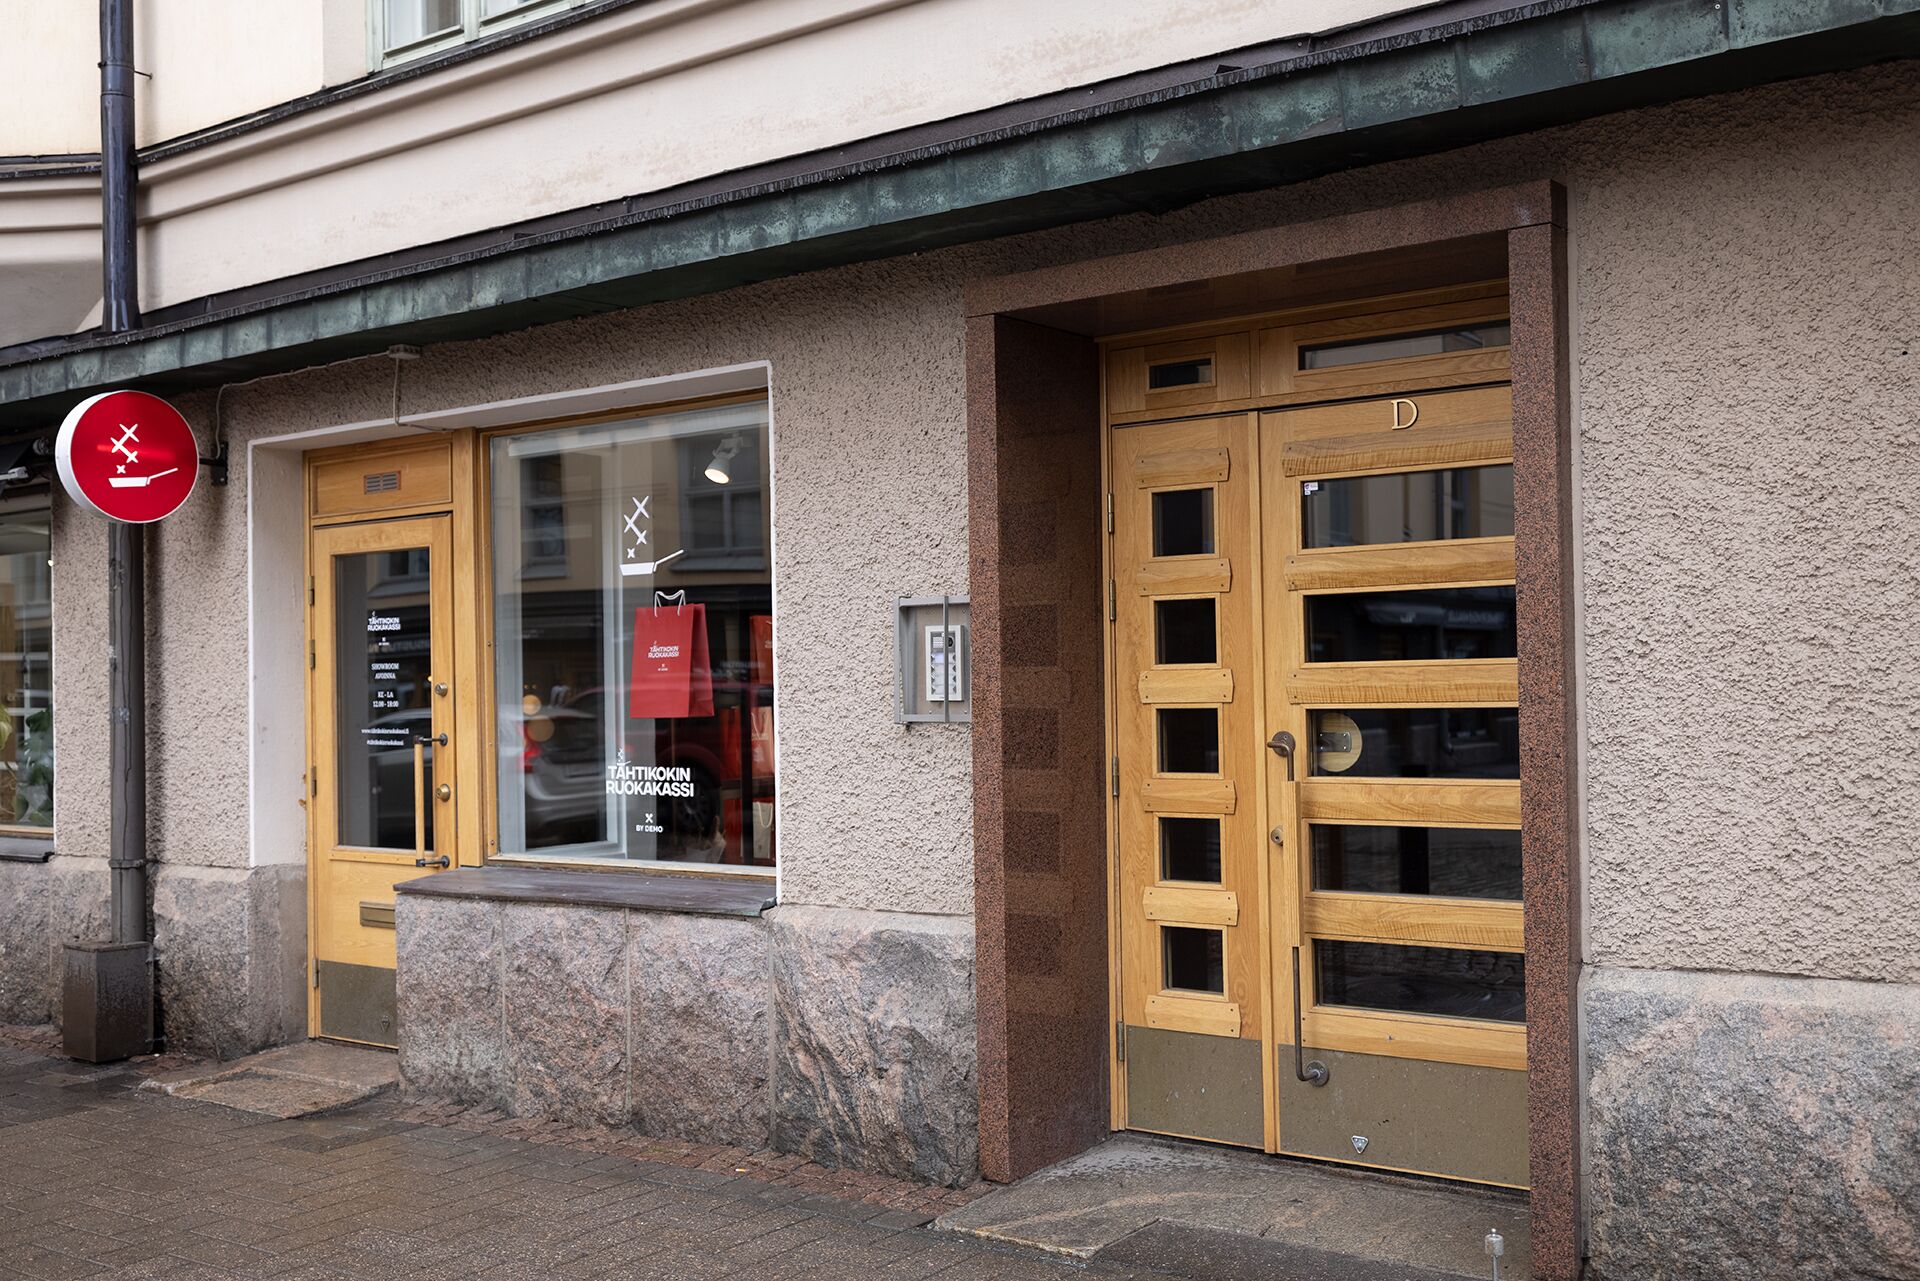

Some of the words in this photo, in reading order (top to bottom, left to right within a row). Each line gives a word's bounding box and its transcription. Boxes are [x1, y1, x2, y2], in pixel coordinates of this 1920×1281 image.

[1391, 399, 1418, 430] D
[371, 662, 399, 670] SHOWROOM
[606, 780, 694, 798] RUOKAKASSI
[635, 824, 644, 832] BY
[644, 825, 664, 833] DEMO
